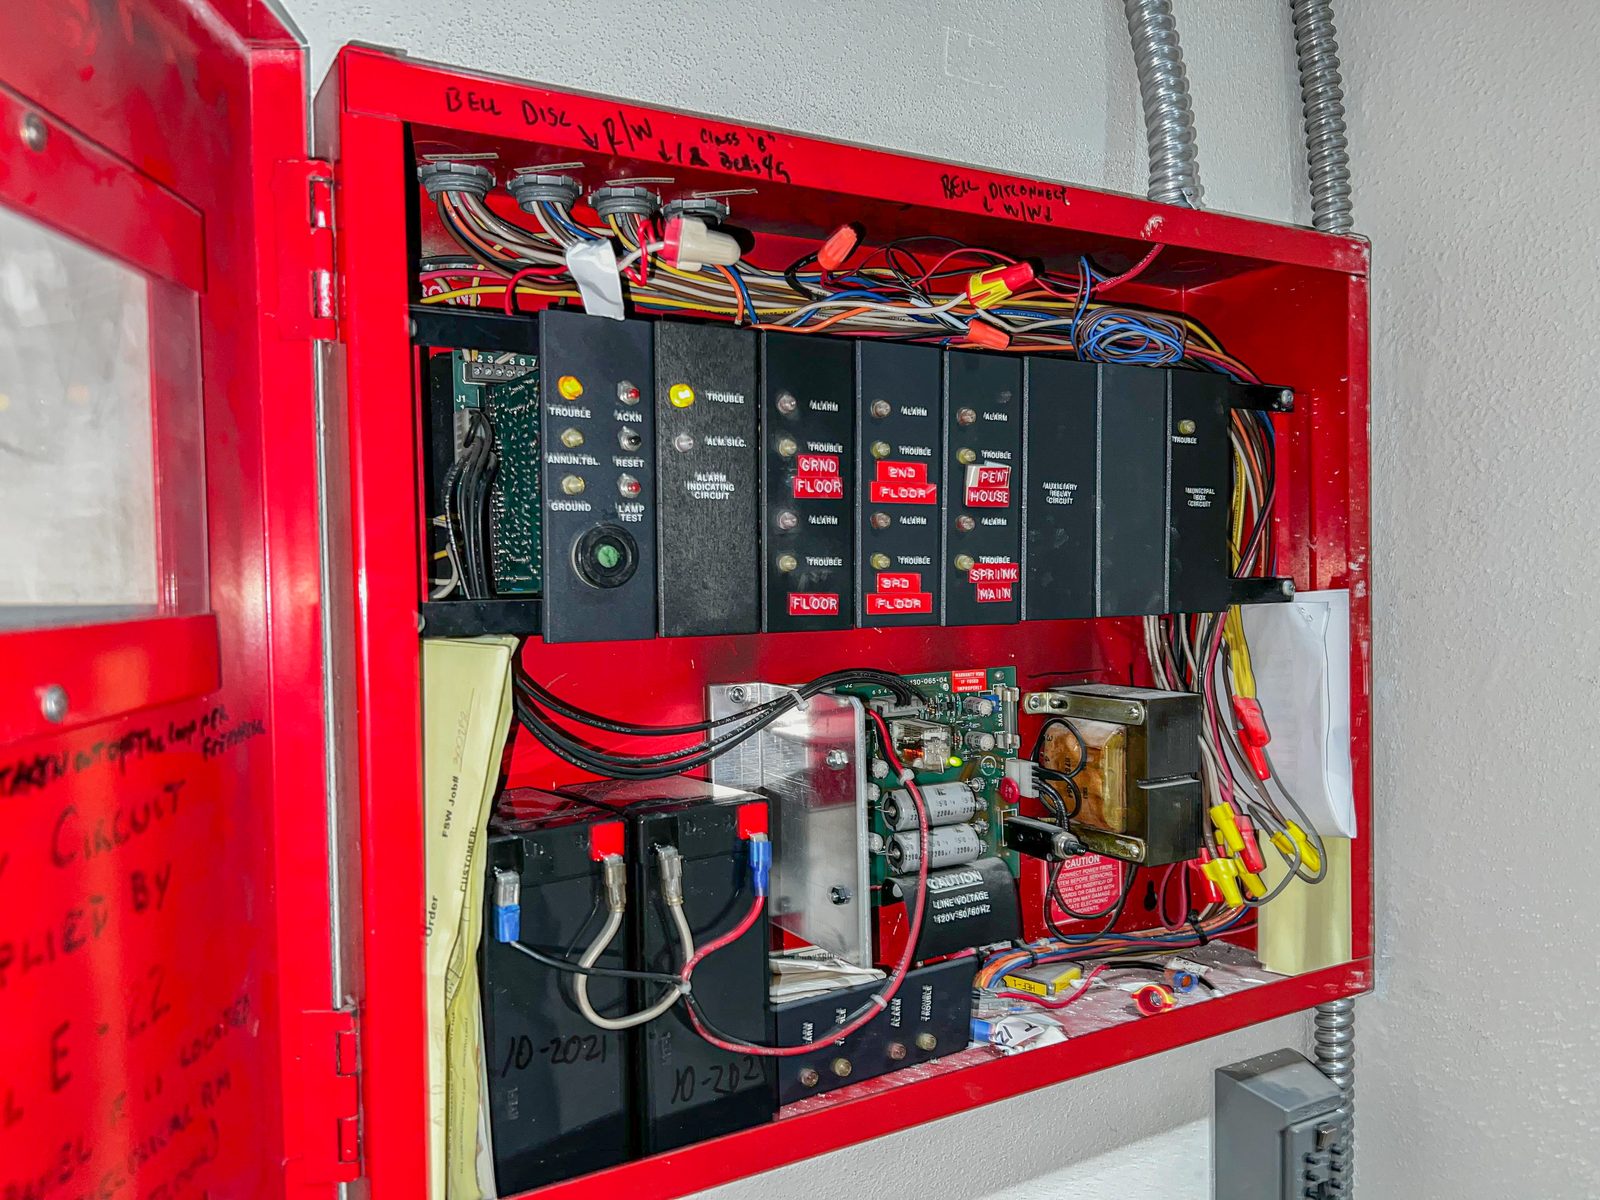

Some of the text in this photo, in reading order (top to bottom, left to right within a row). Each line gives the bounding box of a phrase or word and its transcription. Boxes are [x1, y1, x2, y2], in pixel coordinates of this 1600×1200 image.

[521, 100, 571, 127] DISC
[941, 173, 979, 199] BELL
[488, 355, 493, 363] 3
[520, 358, 525, 366] 6
[706, 392, 745, 404] TROUBLE
[549, 406, 592, 419] TROUBLE
[810, 401, 839, 412] ALARM
[902, 406, 928, 416] ALARM
[615, 411, 643, 423] ACKN
[984, 413, 1008, 421] ALARM
[1173, 436, 1198, 444] TROUBLE
[809, 443, 843, 453] TROUBLE
[901, 446, 932, 456] TROUBLE
[983, 450, 1012, 459] TROUBLE
[615, 457, 645, 468] RESET
[800, 459, 837, 473] GRND
[696, 472, 727, 482] ALARM
[888, 466, 916, 478] 2ND
[980, 471, 1009, 483] PENT
[686, 482, 735, 492] INDICATING
[797, 479, 842, 493] FLOOR
[694, 491, 730, 500] CIRCUIT
[880, 486, 927, 499] FLOOR
[970, 490, 1009, 503] HOUSE
[1047, 496, 1073, 505] CIRCUIT
[550, 502, 592, 512] GROUND
[617, 502, 645, 513] LAMP
[620, 513, 643, 522] TEST
[810, 515, 838, 525] ALARM
[902, 516, 927, 525] ALARM
[983, 518, 1007, 526] ALARM
[808, 557, 843, 566] TROUBLE
[900, 555, 931, 565] TROUBLE
[982, 556, 1011, 564] TROUBLE
[970, 568, 1018, 580] SPRINK
[881, 577, 910, 589] 3RD
[980, 588, 1012, 600] MAIN
[792, 597, 837, 610] FLOOR
[875, 598, 922, 610] FLOOR
[441, 809, 453, 838] FSW
[1064, 854, 1100, 869] CAUTION
[927, 870, 983, 889] CAUTION
[131, 863, 172, 912] BY
[934, 891, 990, 910] LINE VOLTAGE
[924, 984, 933, 1022] TROUBLE
[894, 997, 902, 1028] ALARM
[806, 1022, 814, 1044] ARM
[502, 1033, 608, 1079] 10-2021
